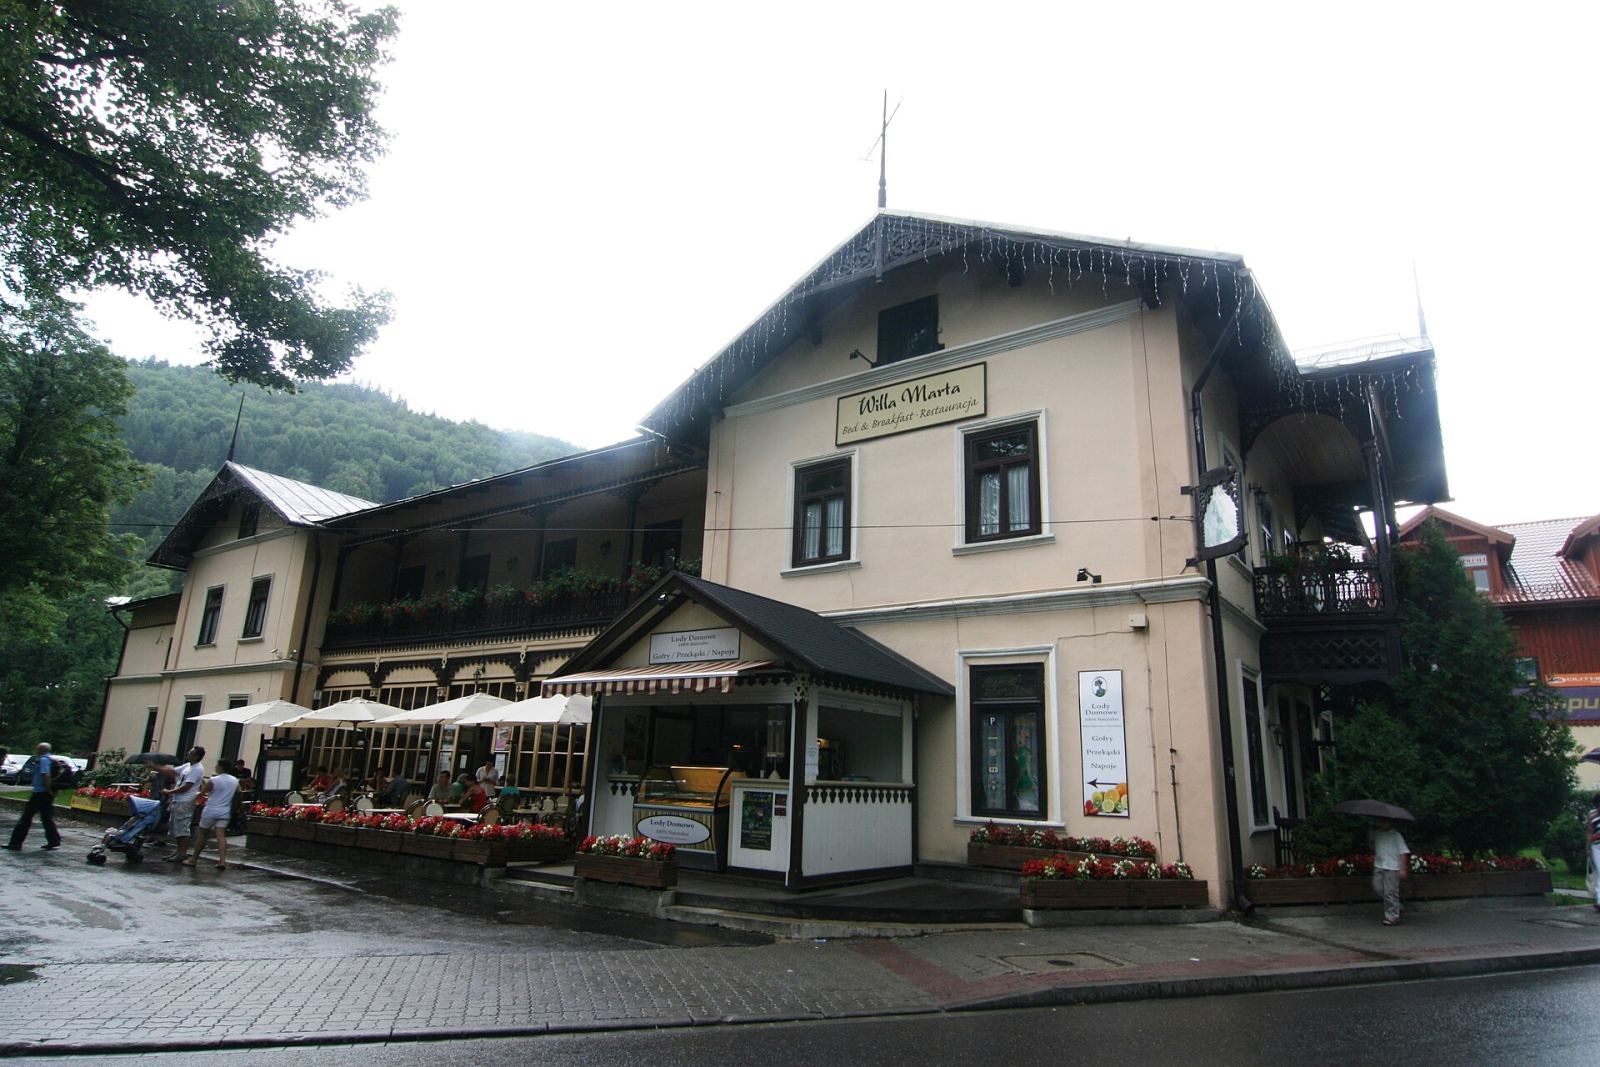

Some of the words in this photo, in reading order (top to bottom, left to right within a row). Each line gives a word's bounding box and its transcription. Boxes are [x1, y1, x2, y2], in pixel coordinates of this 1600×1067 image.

[858, 393, 897, 415] Willa
[901, 382, 961, 404] Marta
[842, 423, 859, 435] Bed
[860, 422, 869, 431] &
[872, 411, 914, 429] Breakfast
[919, 396, 978, 418] Restauracja
[1091, 762, 1117, 770] Napoje
